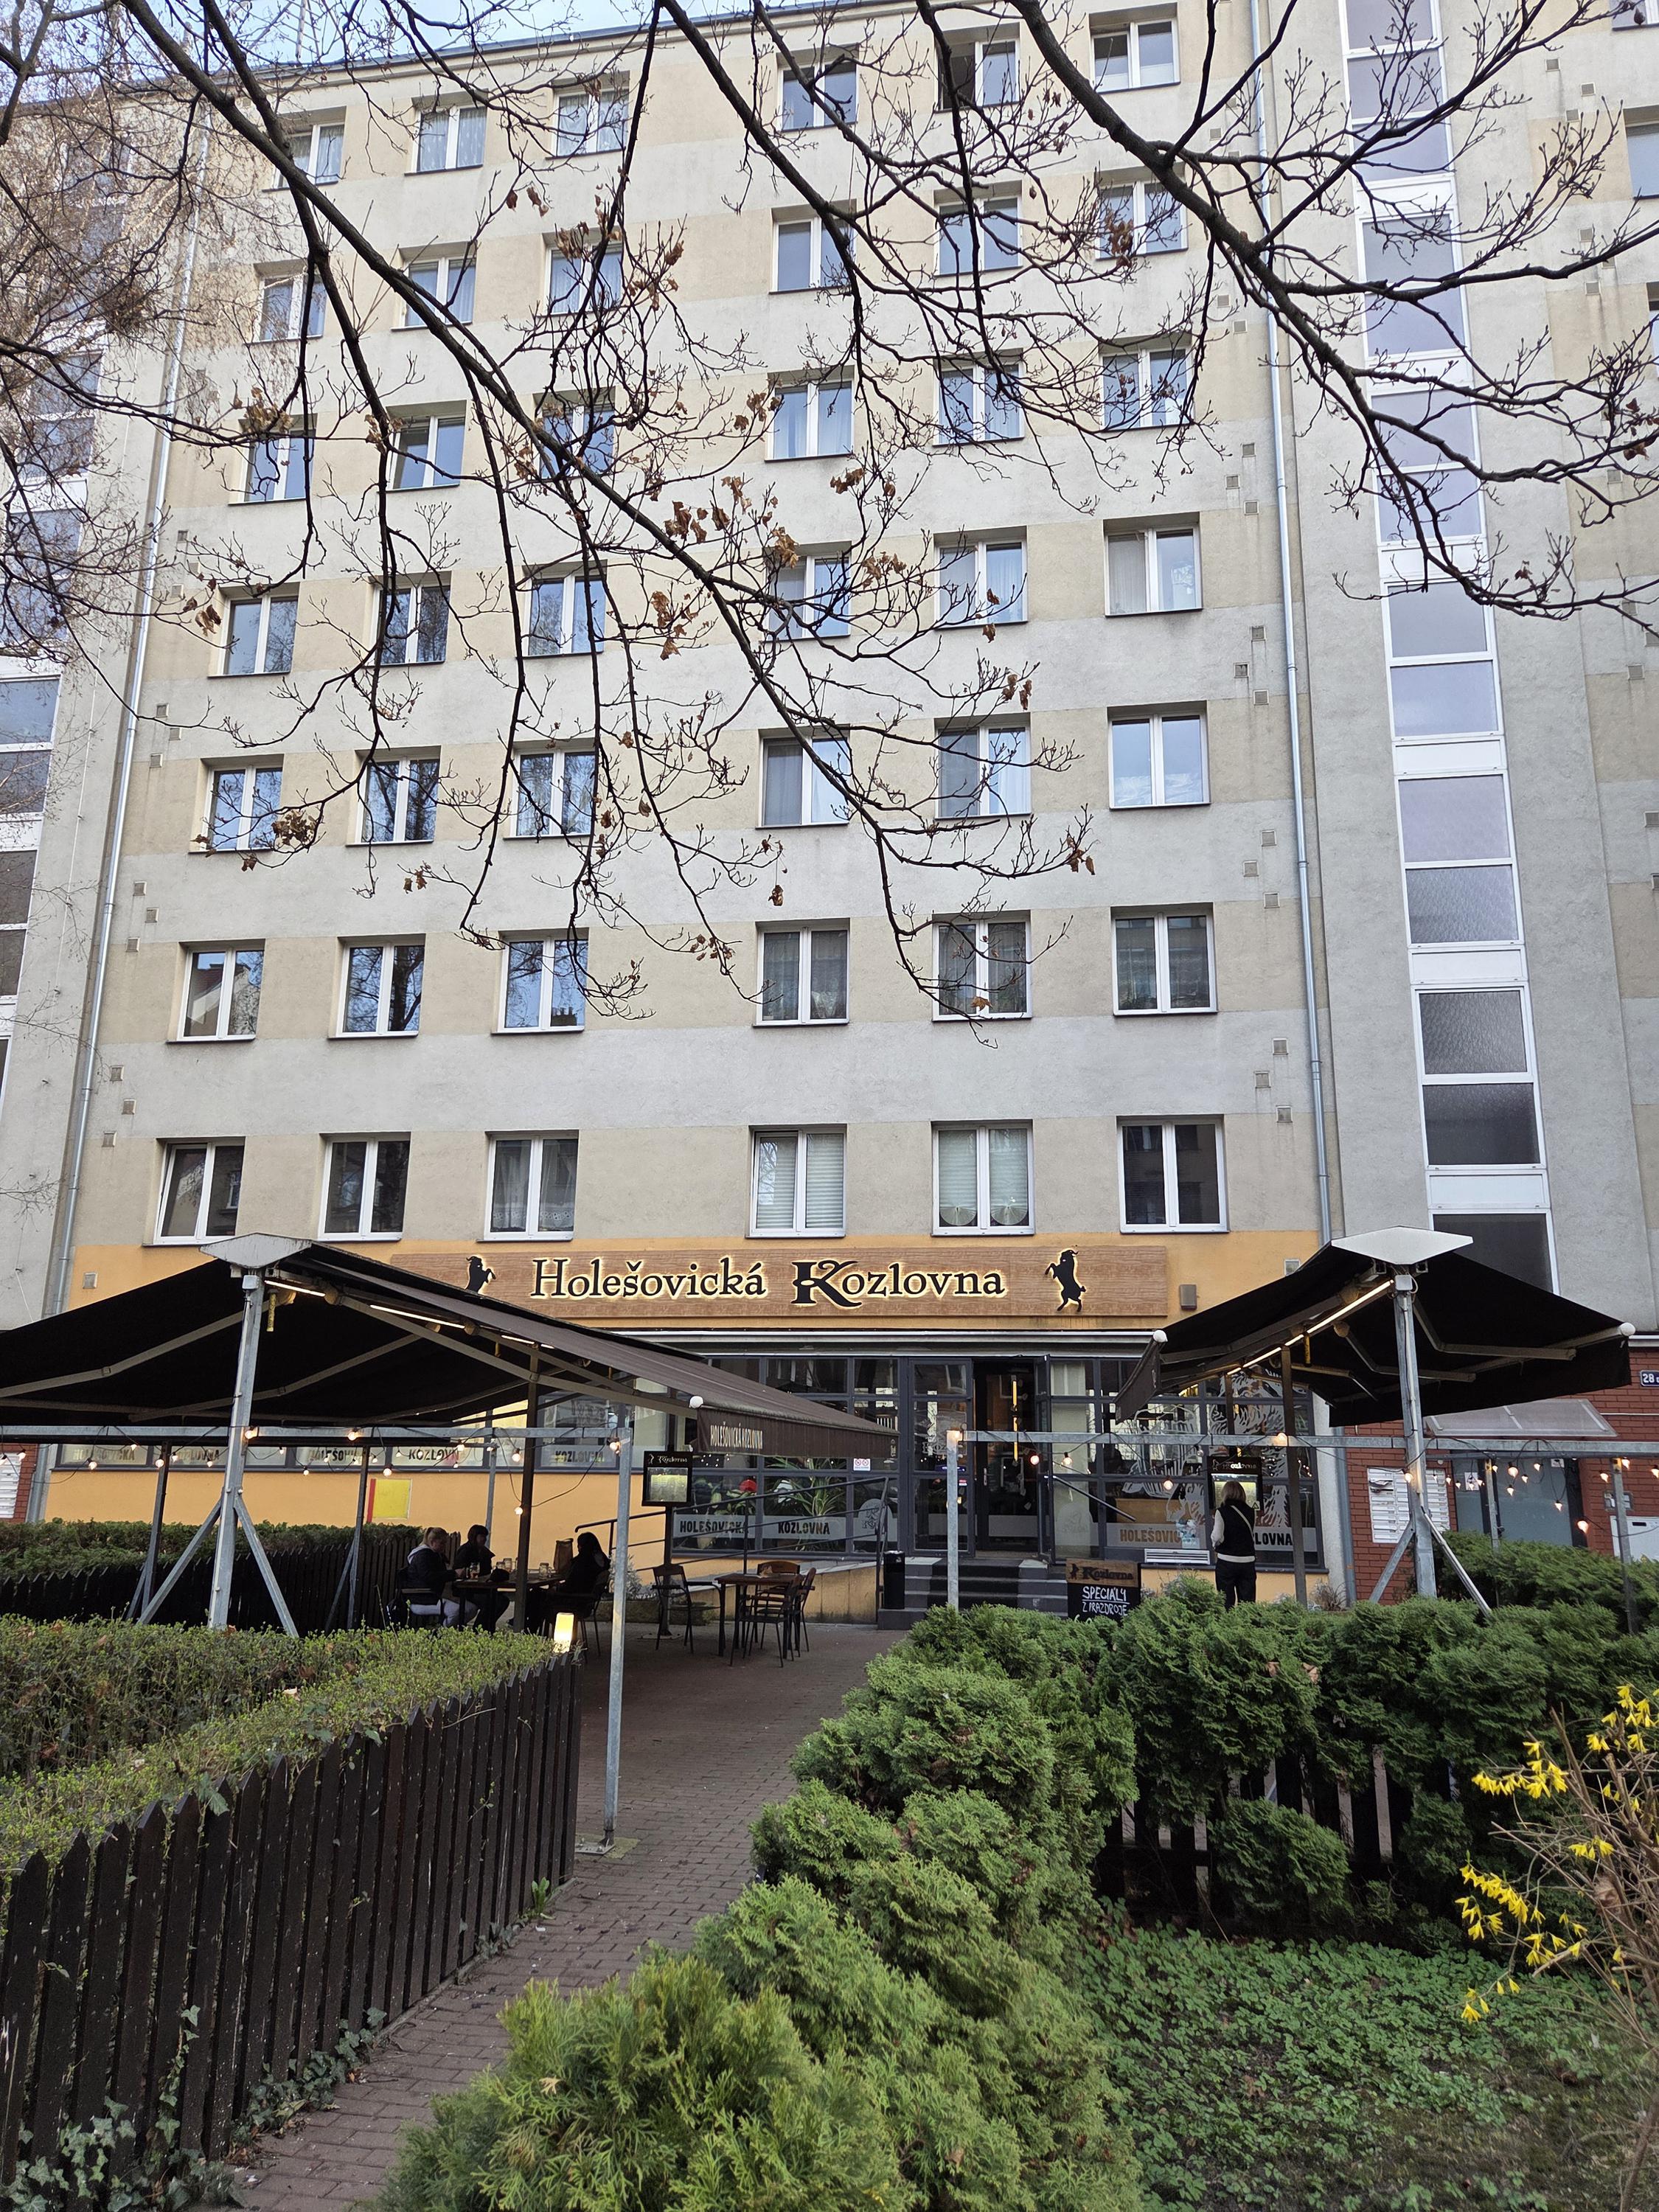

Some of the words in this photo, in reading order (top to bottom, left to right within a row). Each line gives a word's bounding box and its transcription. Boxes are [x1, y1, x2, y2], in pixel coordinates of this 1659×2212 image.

[530, 1256, 766, 1298] Holešovická
[791, 1259, 1006, 1307] Kozlovna
[1642, 1374, 1655, 1383] 28
[408, 1448, 459, 1461] KOZLOVN
[778, 1521, 831, 1535] KOZLOVNA
[1120, 1527, 1181, 1544] HOLEŠOVIC
[1254, 1531, 1293, 1546] LOVNA
[1081, 1566, 1134, 1581] Kozlovna
[1082, 1585, 1127, 1601] SPECIÁLY
[1082, 1601, 1088, 1613] Z
